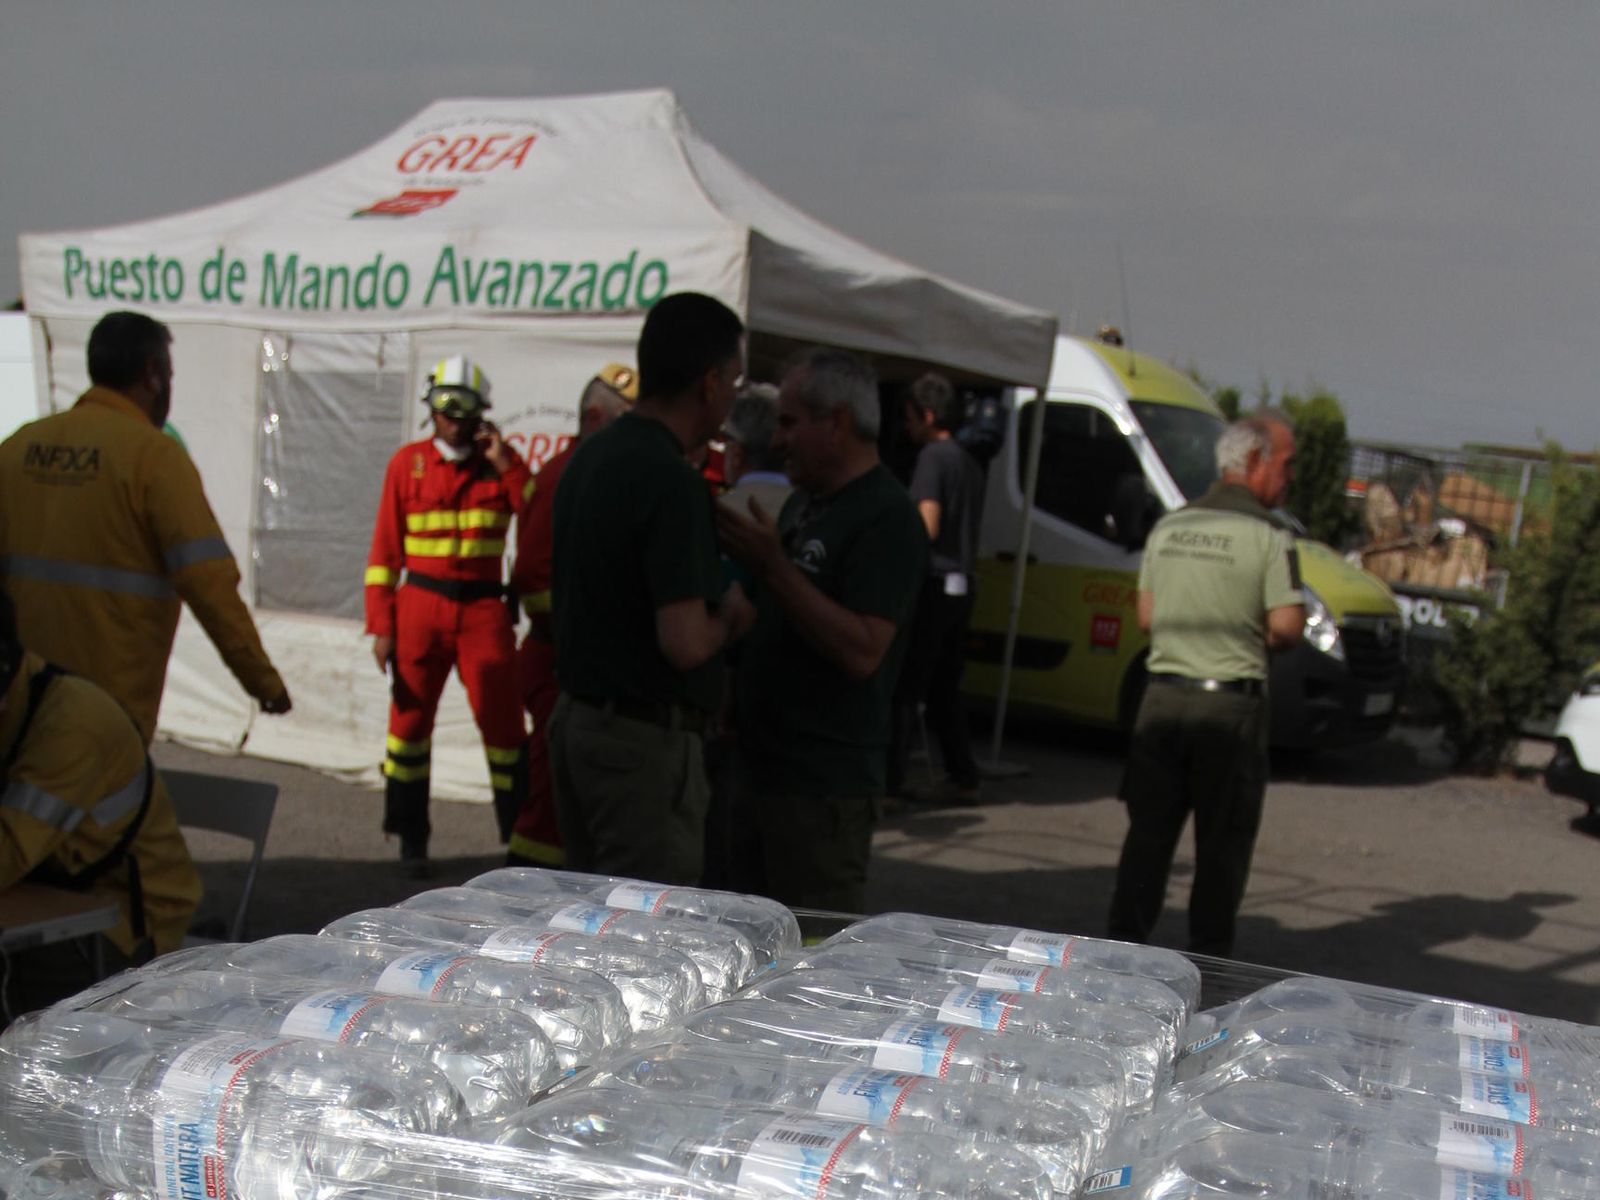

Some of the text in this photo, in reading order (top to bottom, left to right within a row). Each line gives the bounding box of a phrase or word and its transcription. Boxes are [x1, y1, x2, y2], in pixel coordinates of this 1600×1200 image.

[397, 133, 538, 173] GREA
[64, 244, 668, 309] Puesto de Mando Avanzado
[1168, 530, 1233, 553] AGENTE
[178, 1123, 201, 1186] NATURA
